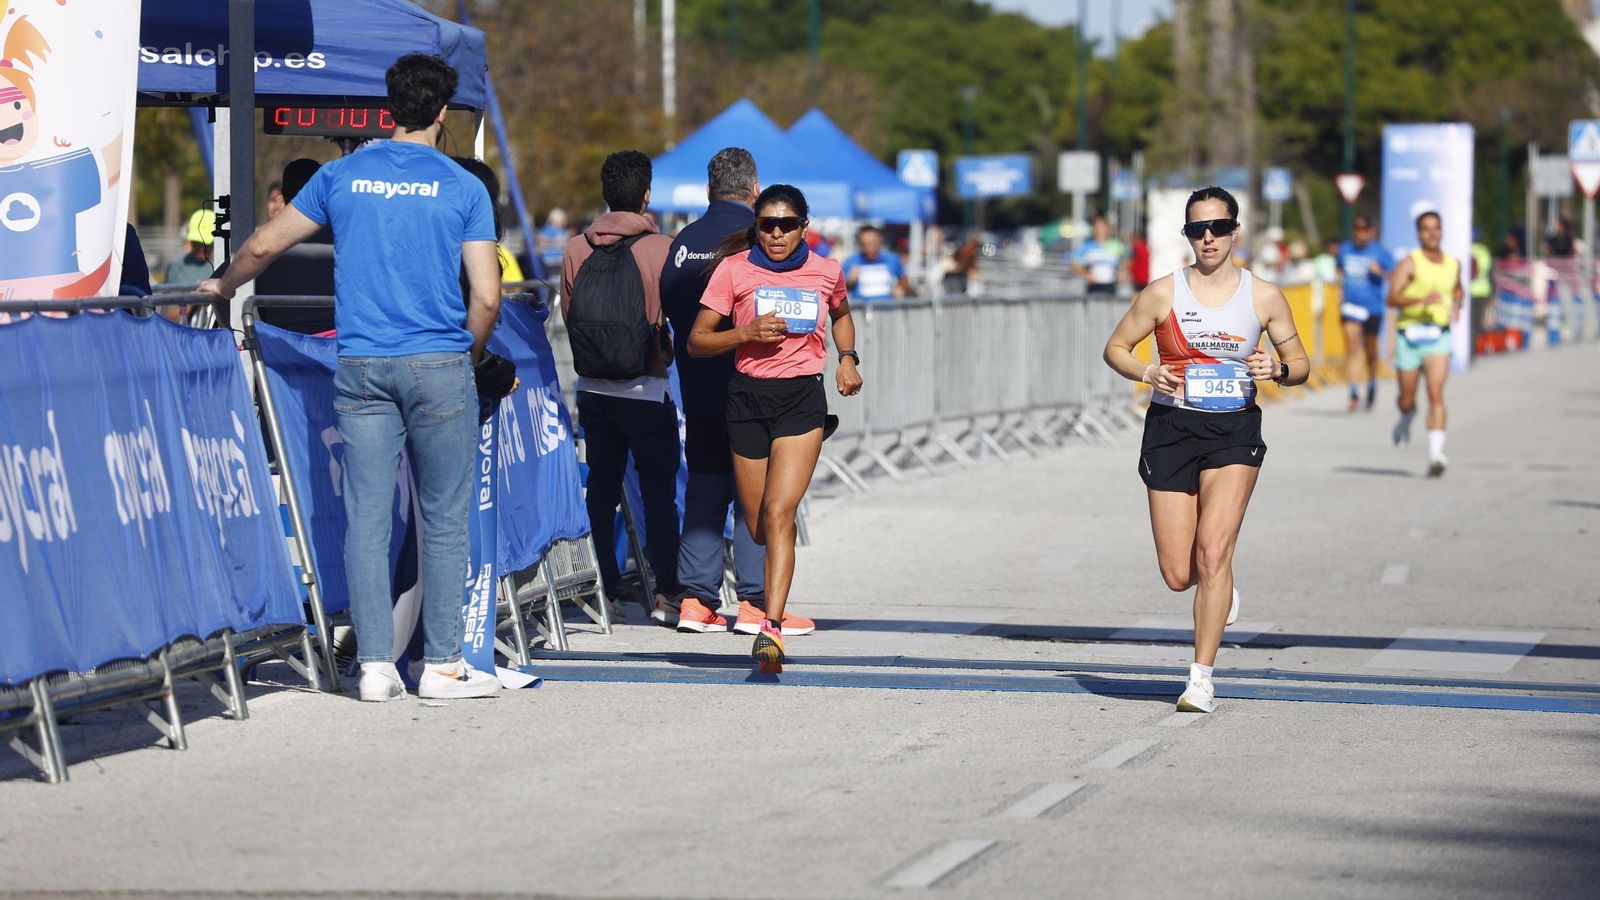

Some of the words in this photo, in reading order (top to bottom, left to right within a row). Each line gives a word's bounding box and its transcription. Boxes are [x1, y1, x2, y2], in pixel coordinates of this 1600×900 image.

[351, 179, 440, 200] mayoral
[775, 301, 802, 316] 508
[1204, 380, 1235, 394] 945
